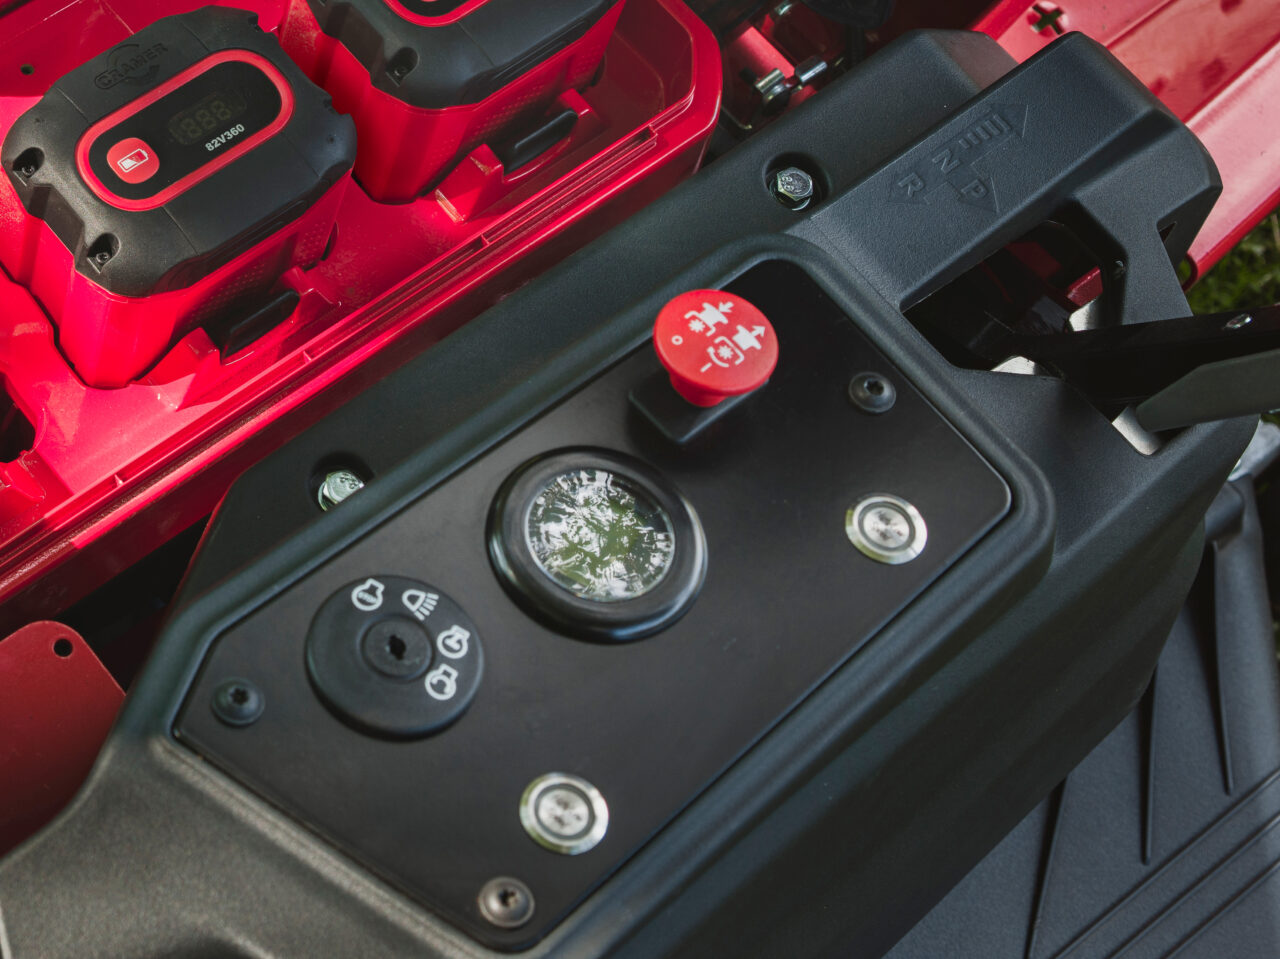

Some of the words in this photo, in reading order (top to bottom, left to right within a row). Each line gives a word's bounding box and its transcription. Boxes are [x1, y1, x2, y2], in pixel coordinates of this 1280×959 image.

[96, 42, 169, 88] CRAMER
[204, 123, 246, 152] 82V360
[931, 149, 962, 175] N
[897, 172, 926, 198] R
[960, 178, 989, 199] P
